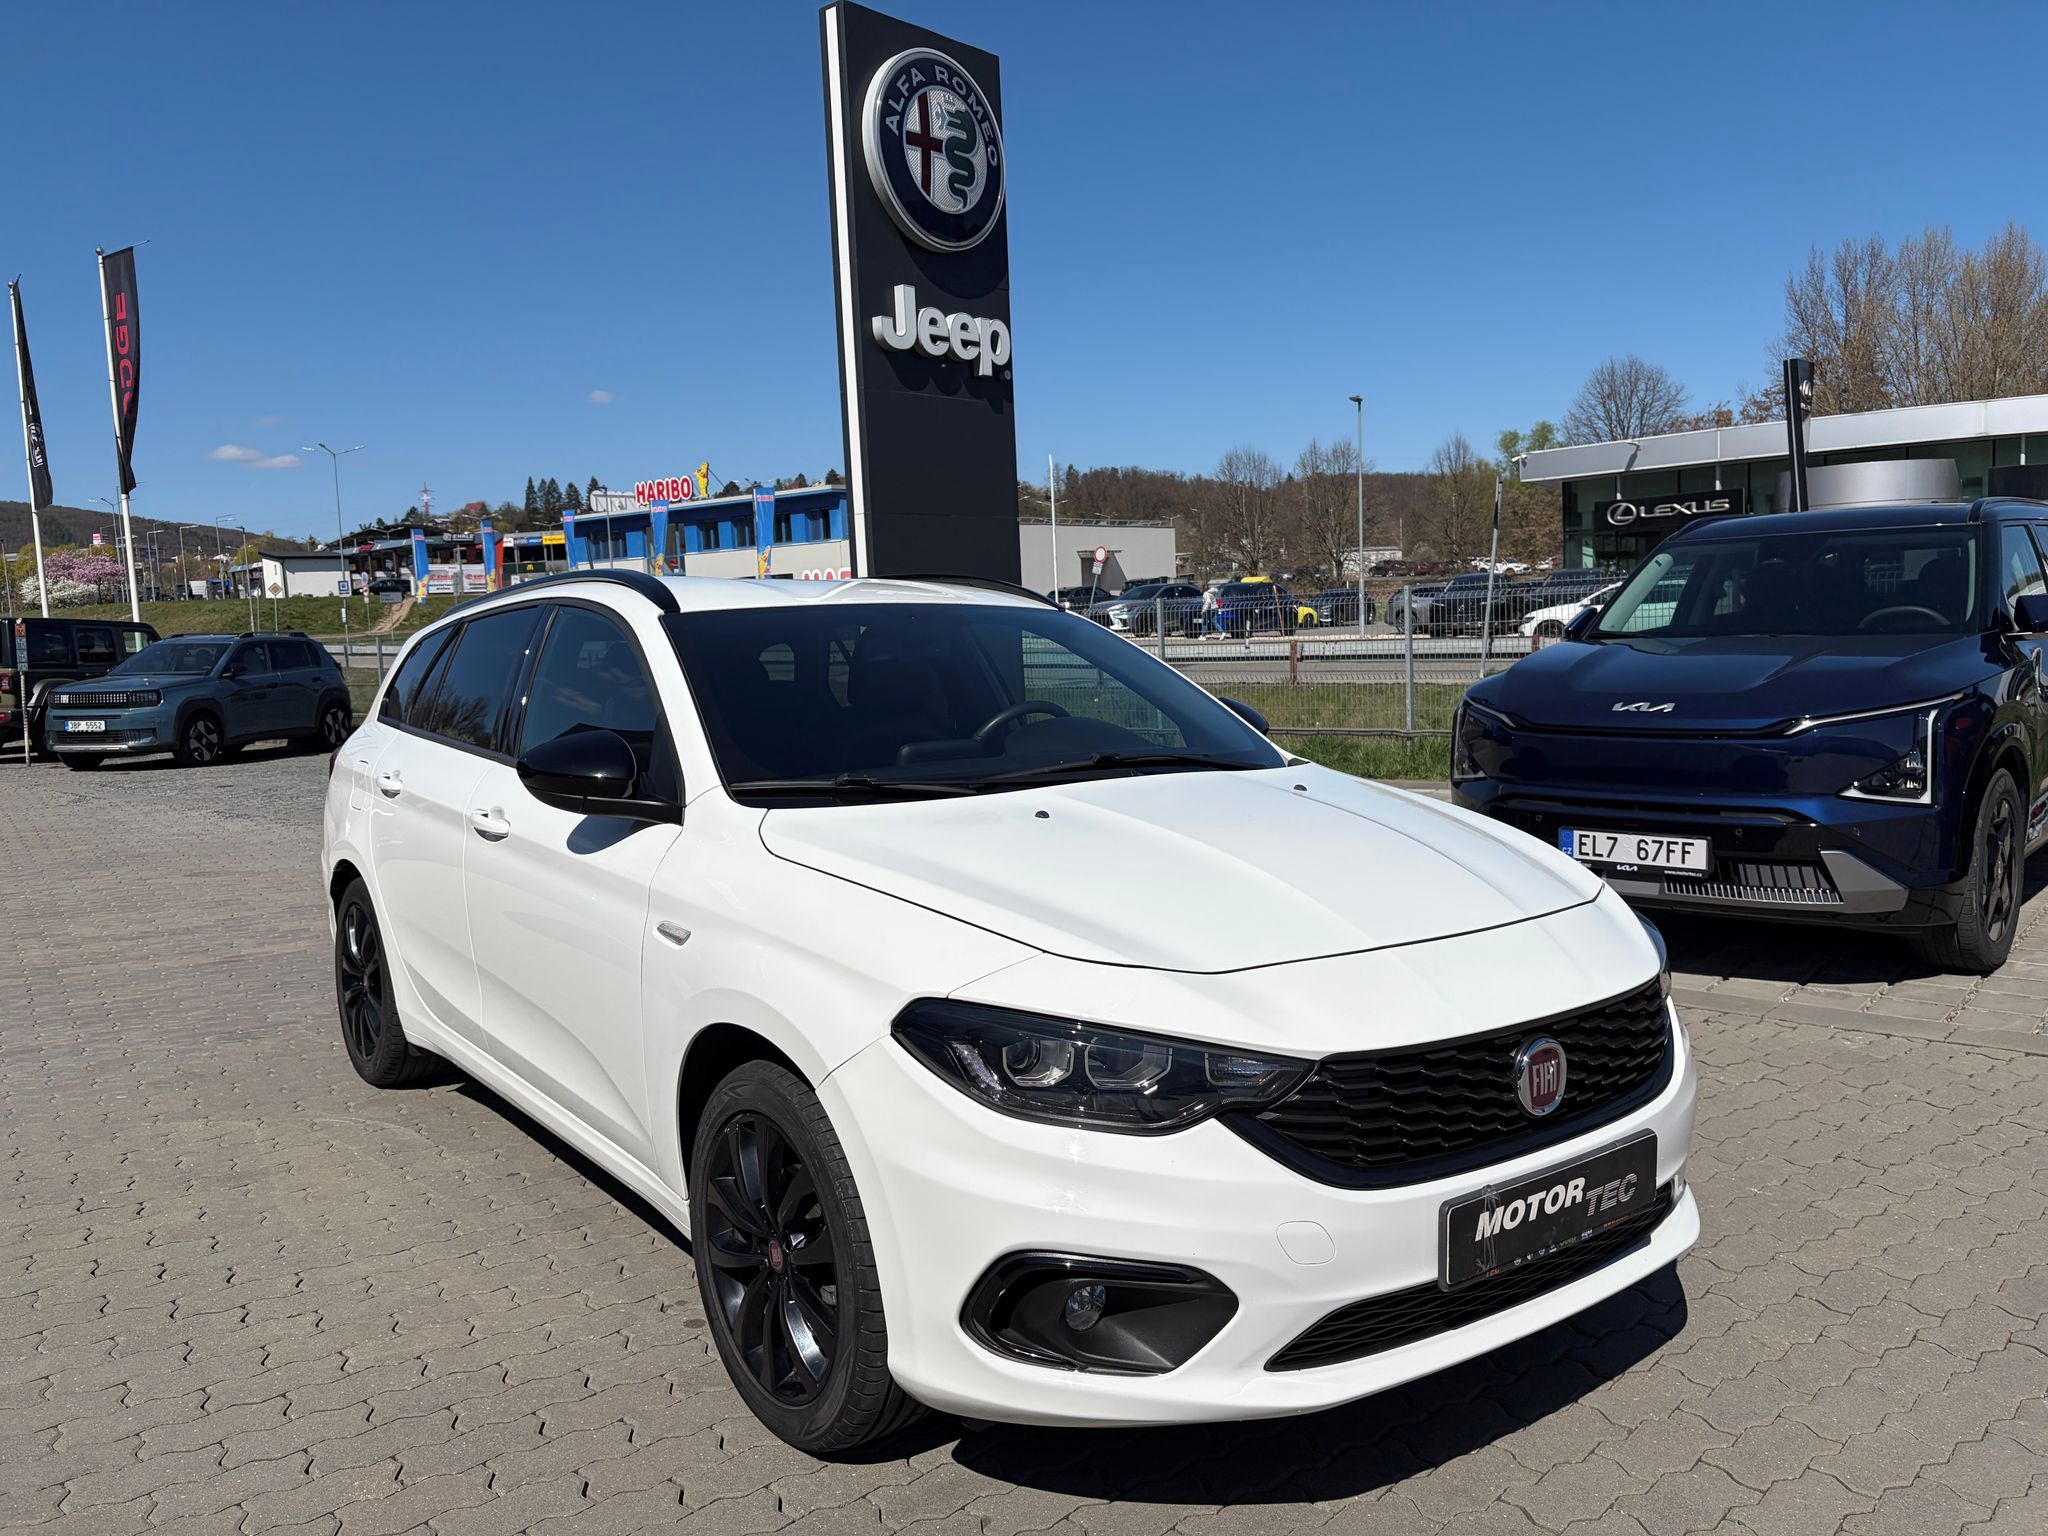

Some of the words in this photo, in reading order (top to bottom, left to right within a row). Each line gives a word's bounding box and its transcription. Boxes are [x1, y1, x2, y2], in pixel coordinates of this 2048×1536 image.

[885, 66, 926, 137] ALFA
[933, 64, 998, 168] ROMEO
[872, 284, 1011, 377] Jeep
[634, 476, 693, 505] HARIBO
[1639, 498, 1731, 518] LEXUS
[1611, 701, 1676, 713] KIA
[86, 721, 103, 730] 5552
[1578, 833, 1619, 859] EL7
[1636, 838, 1695, 865] 67FF
[1531, 1059, 1559, 1098] FIAT
[1474, 1176, 1586, 1243] MOTOR
[1585, 1172, 1638, 1217] TEC
